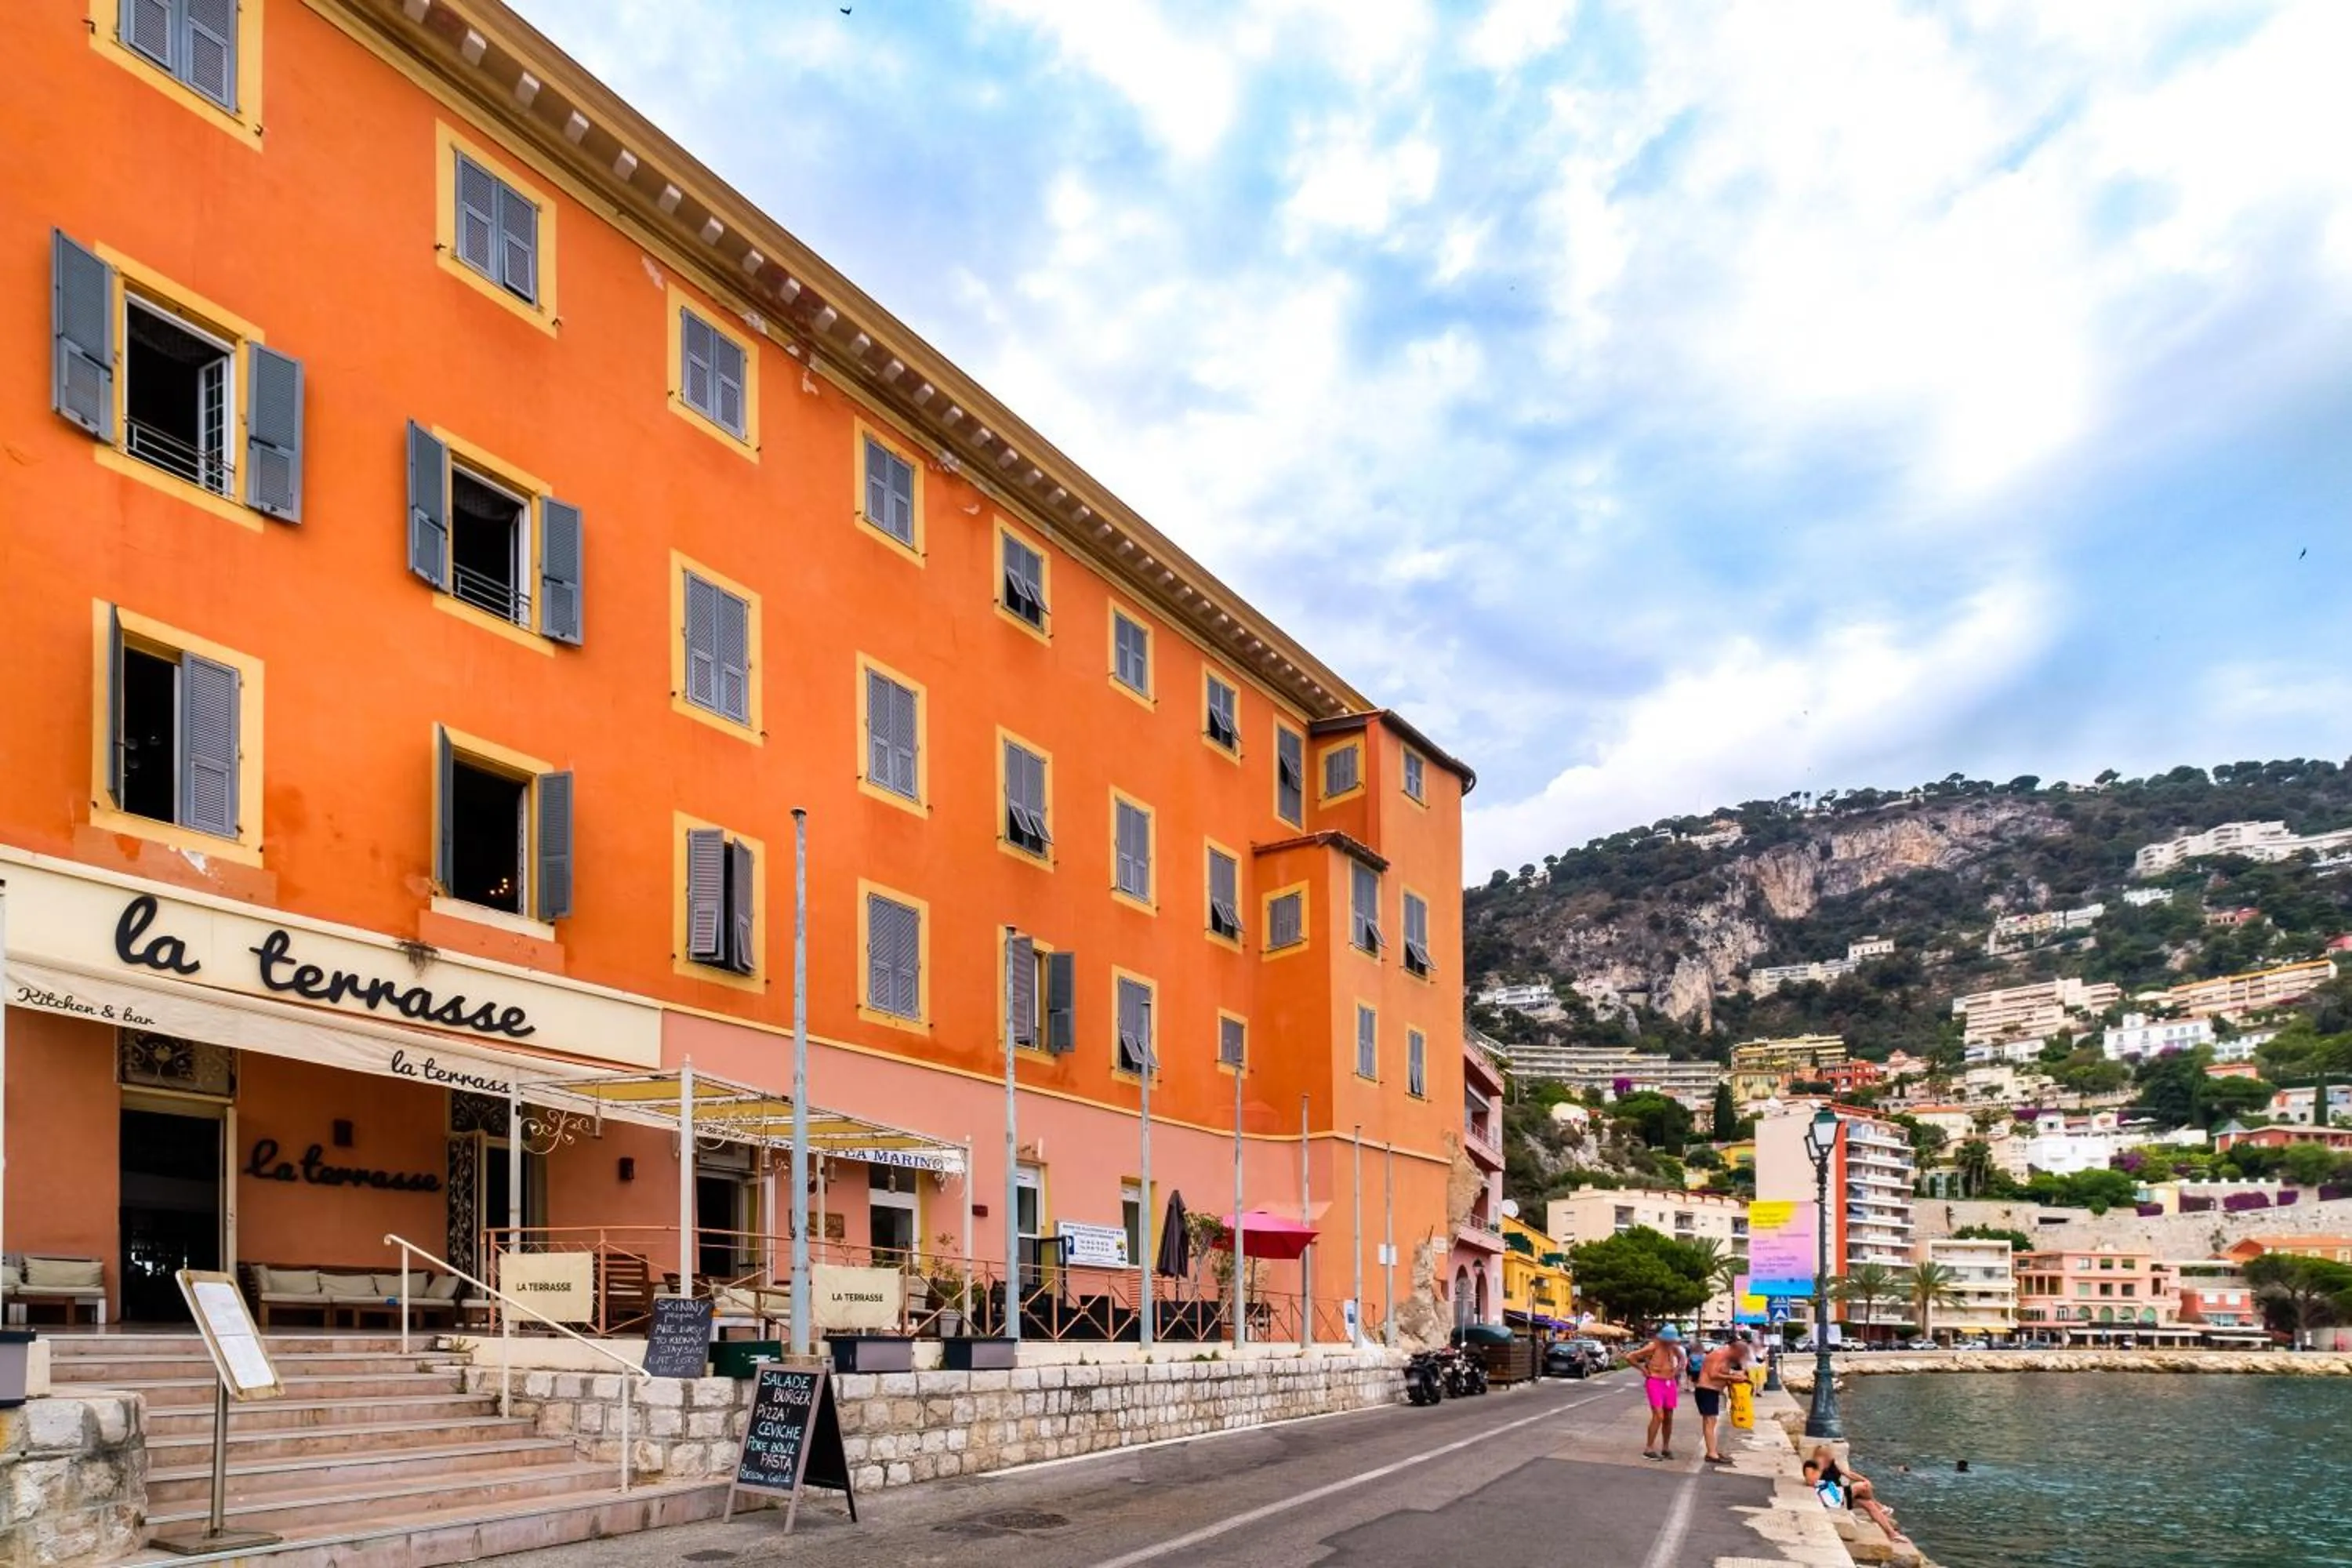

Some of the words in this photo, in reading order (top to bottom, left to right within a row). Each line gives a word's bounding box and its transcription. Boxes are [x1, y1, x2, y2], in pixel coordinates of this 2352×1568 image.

[115, 895, 201, 975] la
[249, 929, 536, 1037] terrasse
[17, 986, 97, 1016] Kitchen
[101, 1004, 114, 1018] &
[123, 1007, 155, 1025] bar
[391, 1049, 417, 1077] la
[421, 1058, 512, 1094] terrass
[299, 1143, 442, 1192] terrasse
[873, 1149, 943, 1169] MARIN
[517, 1283, 527, 1292] LA
[528, 1282, 572, 1292] TERRASSE
[832, 1293, 843, 1301] LA
[844, 1293, 884, 1302] TERRASSE
[657, 1299, 709, 1317] SKINNY
[761, 1372, 811, 1389] SALADE
[772, 1388, 811, 1406] BURGER
[757, 1421, 802, 1439] CEVICHE
[760, 1453, 793, 1472] PASTA
